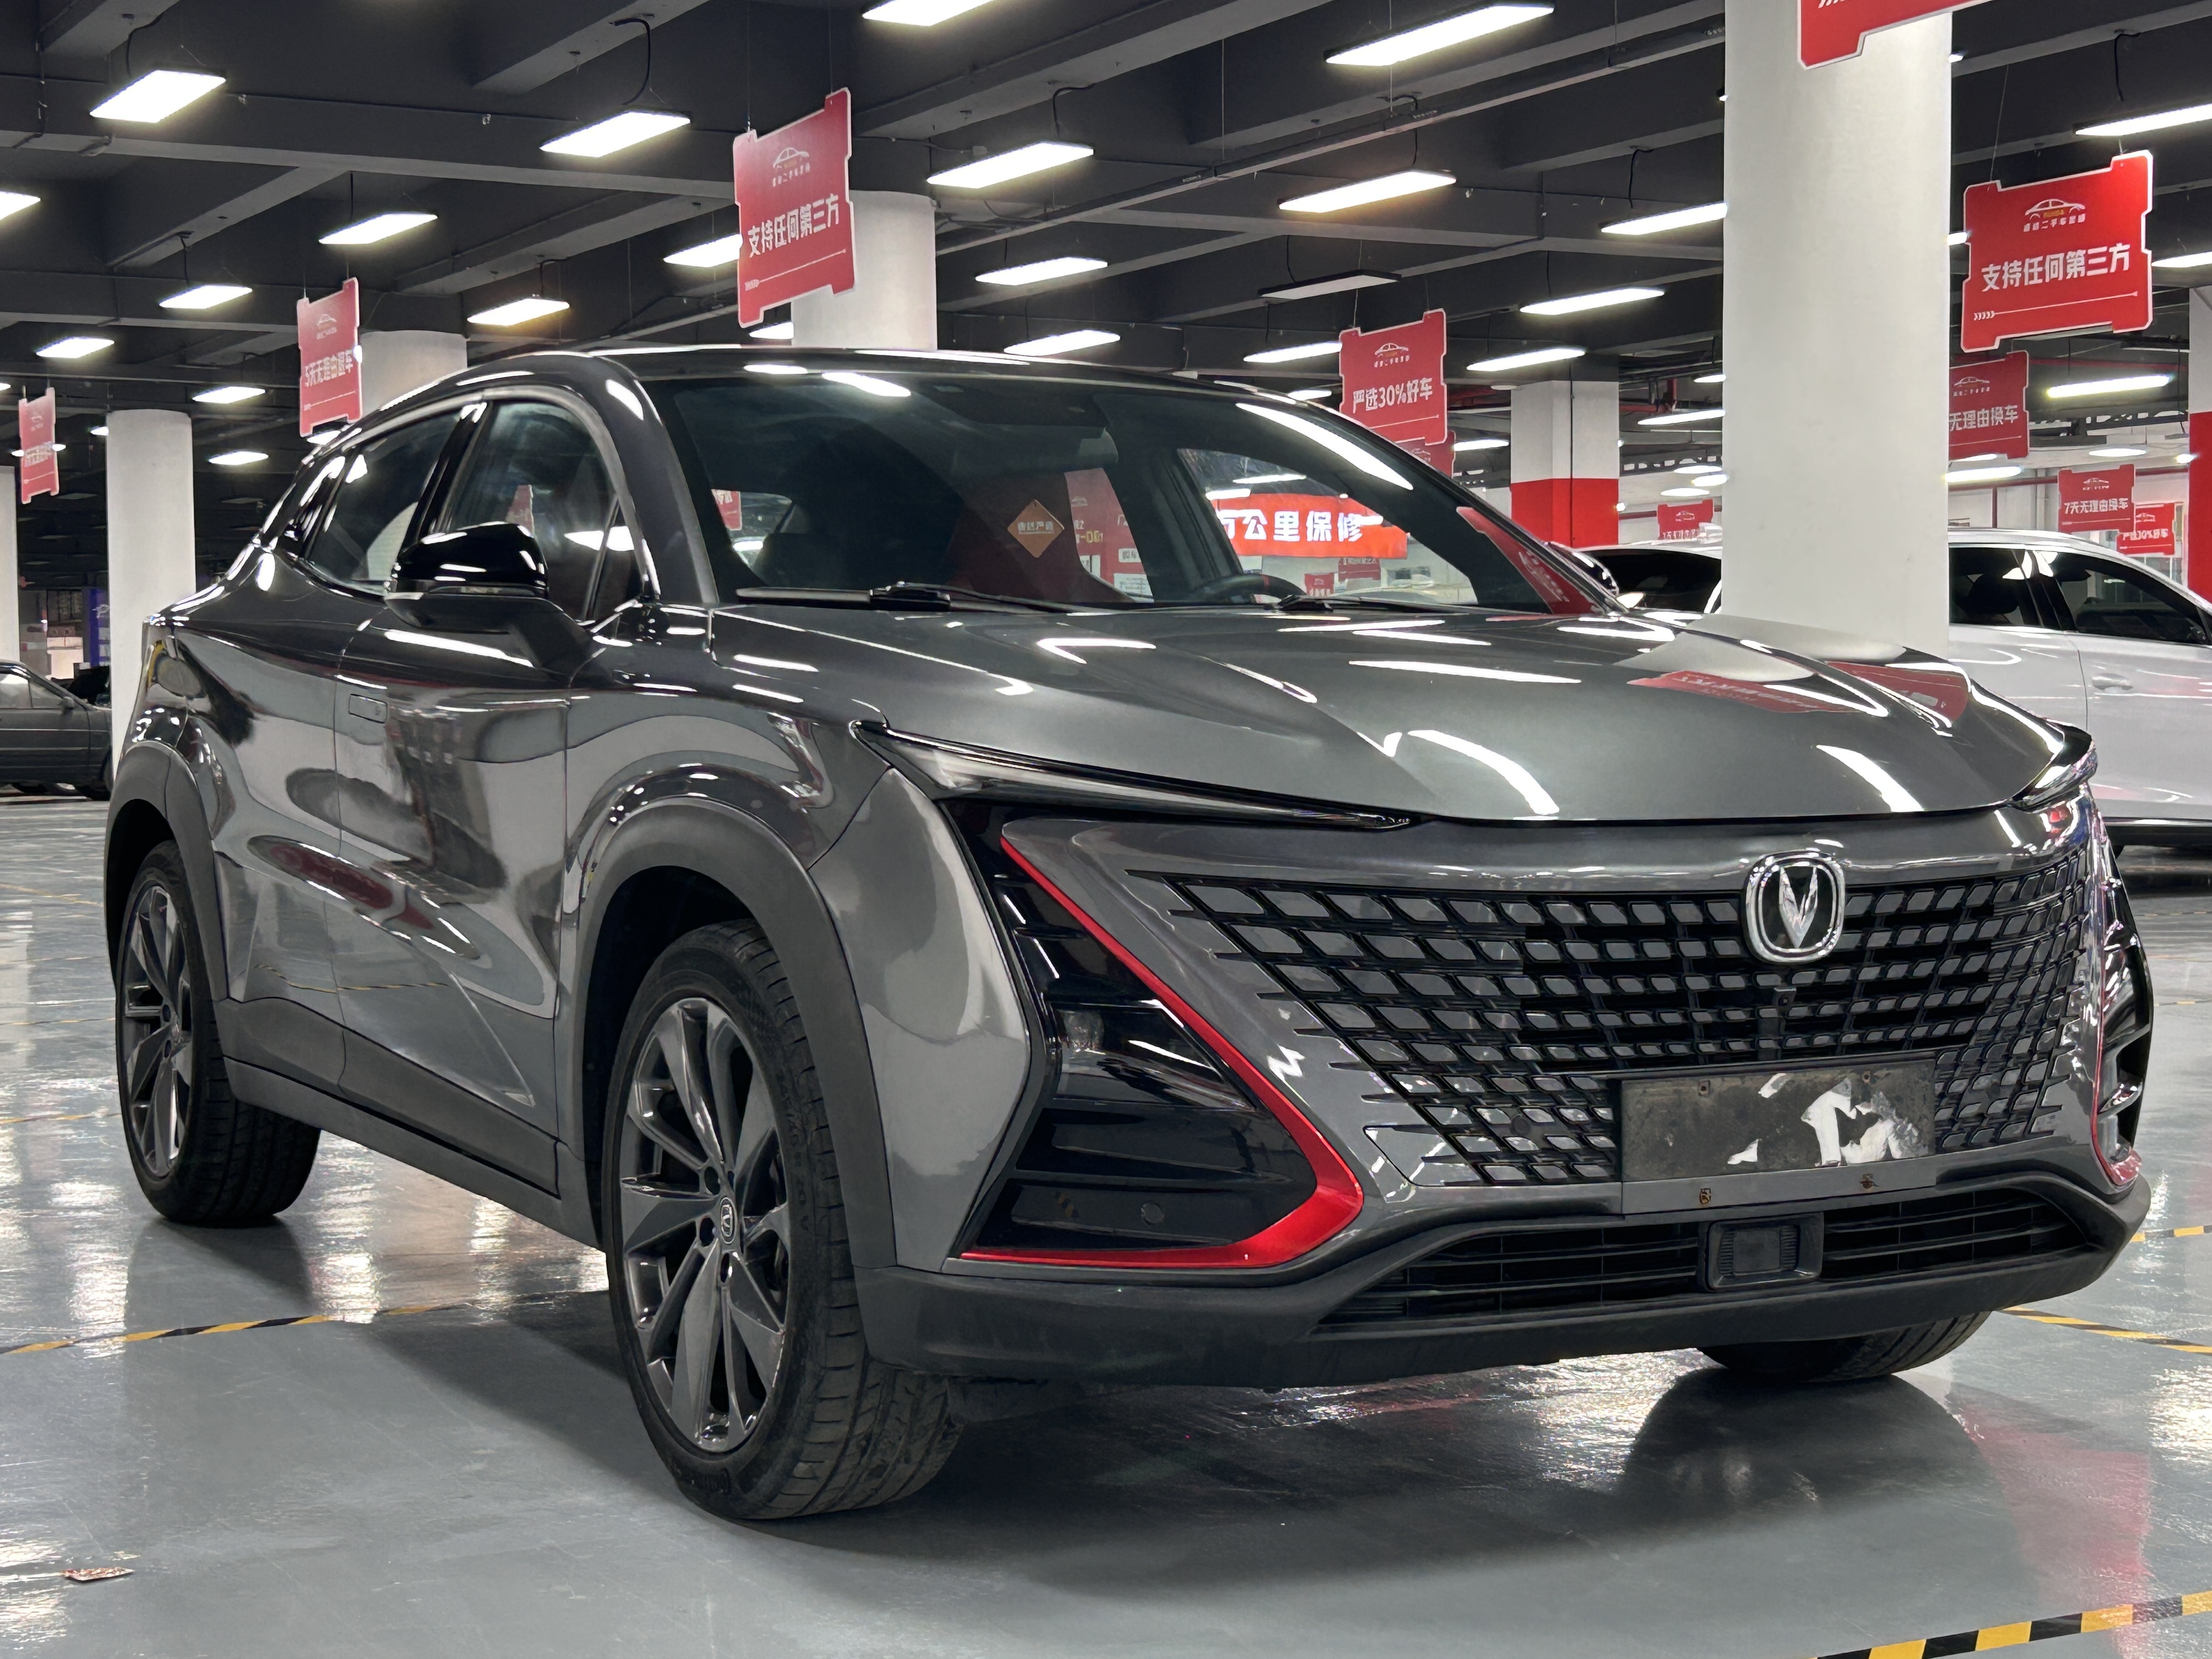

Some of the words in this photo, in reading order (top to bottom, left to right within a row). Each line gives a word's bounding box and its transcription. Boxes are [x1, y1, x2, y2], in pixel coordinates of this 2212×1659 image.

[748, 193, 839, 258] 支持任何第三方
[1981, 242, 2131, 292] 支持任何第三方
[1352, 377, 1433, 414] 严选30%好车
